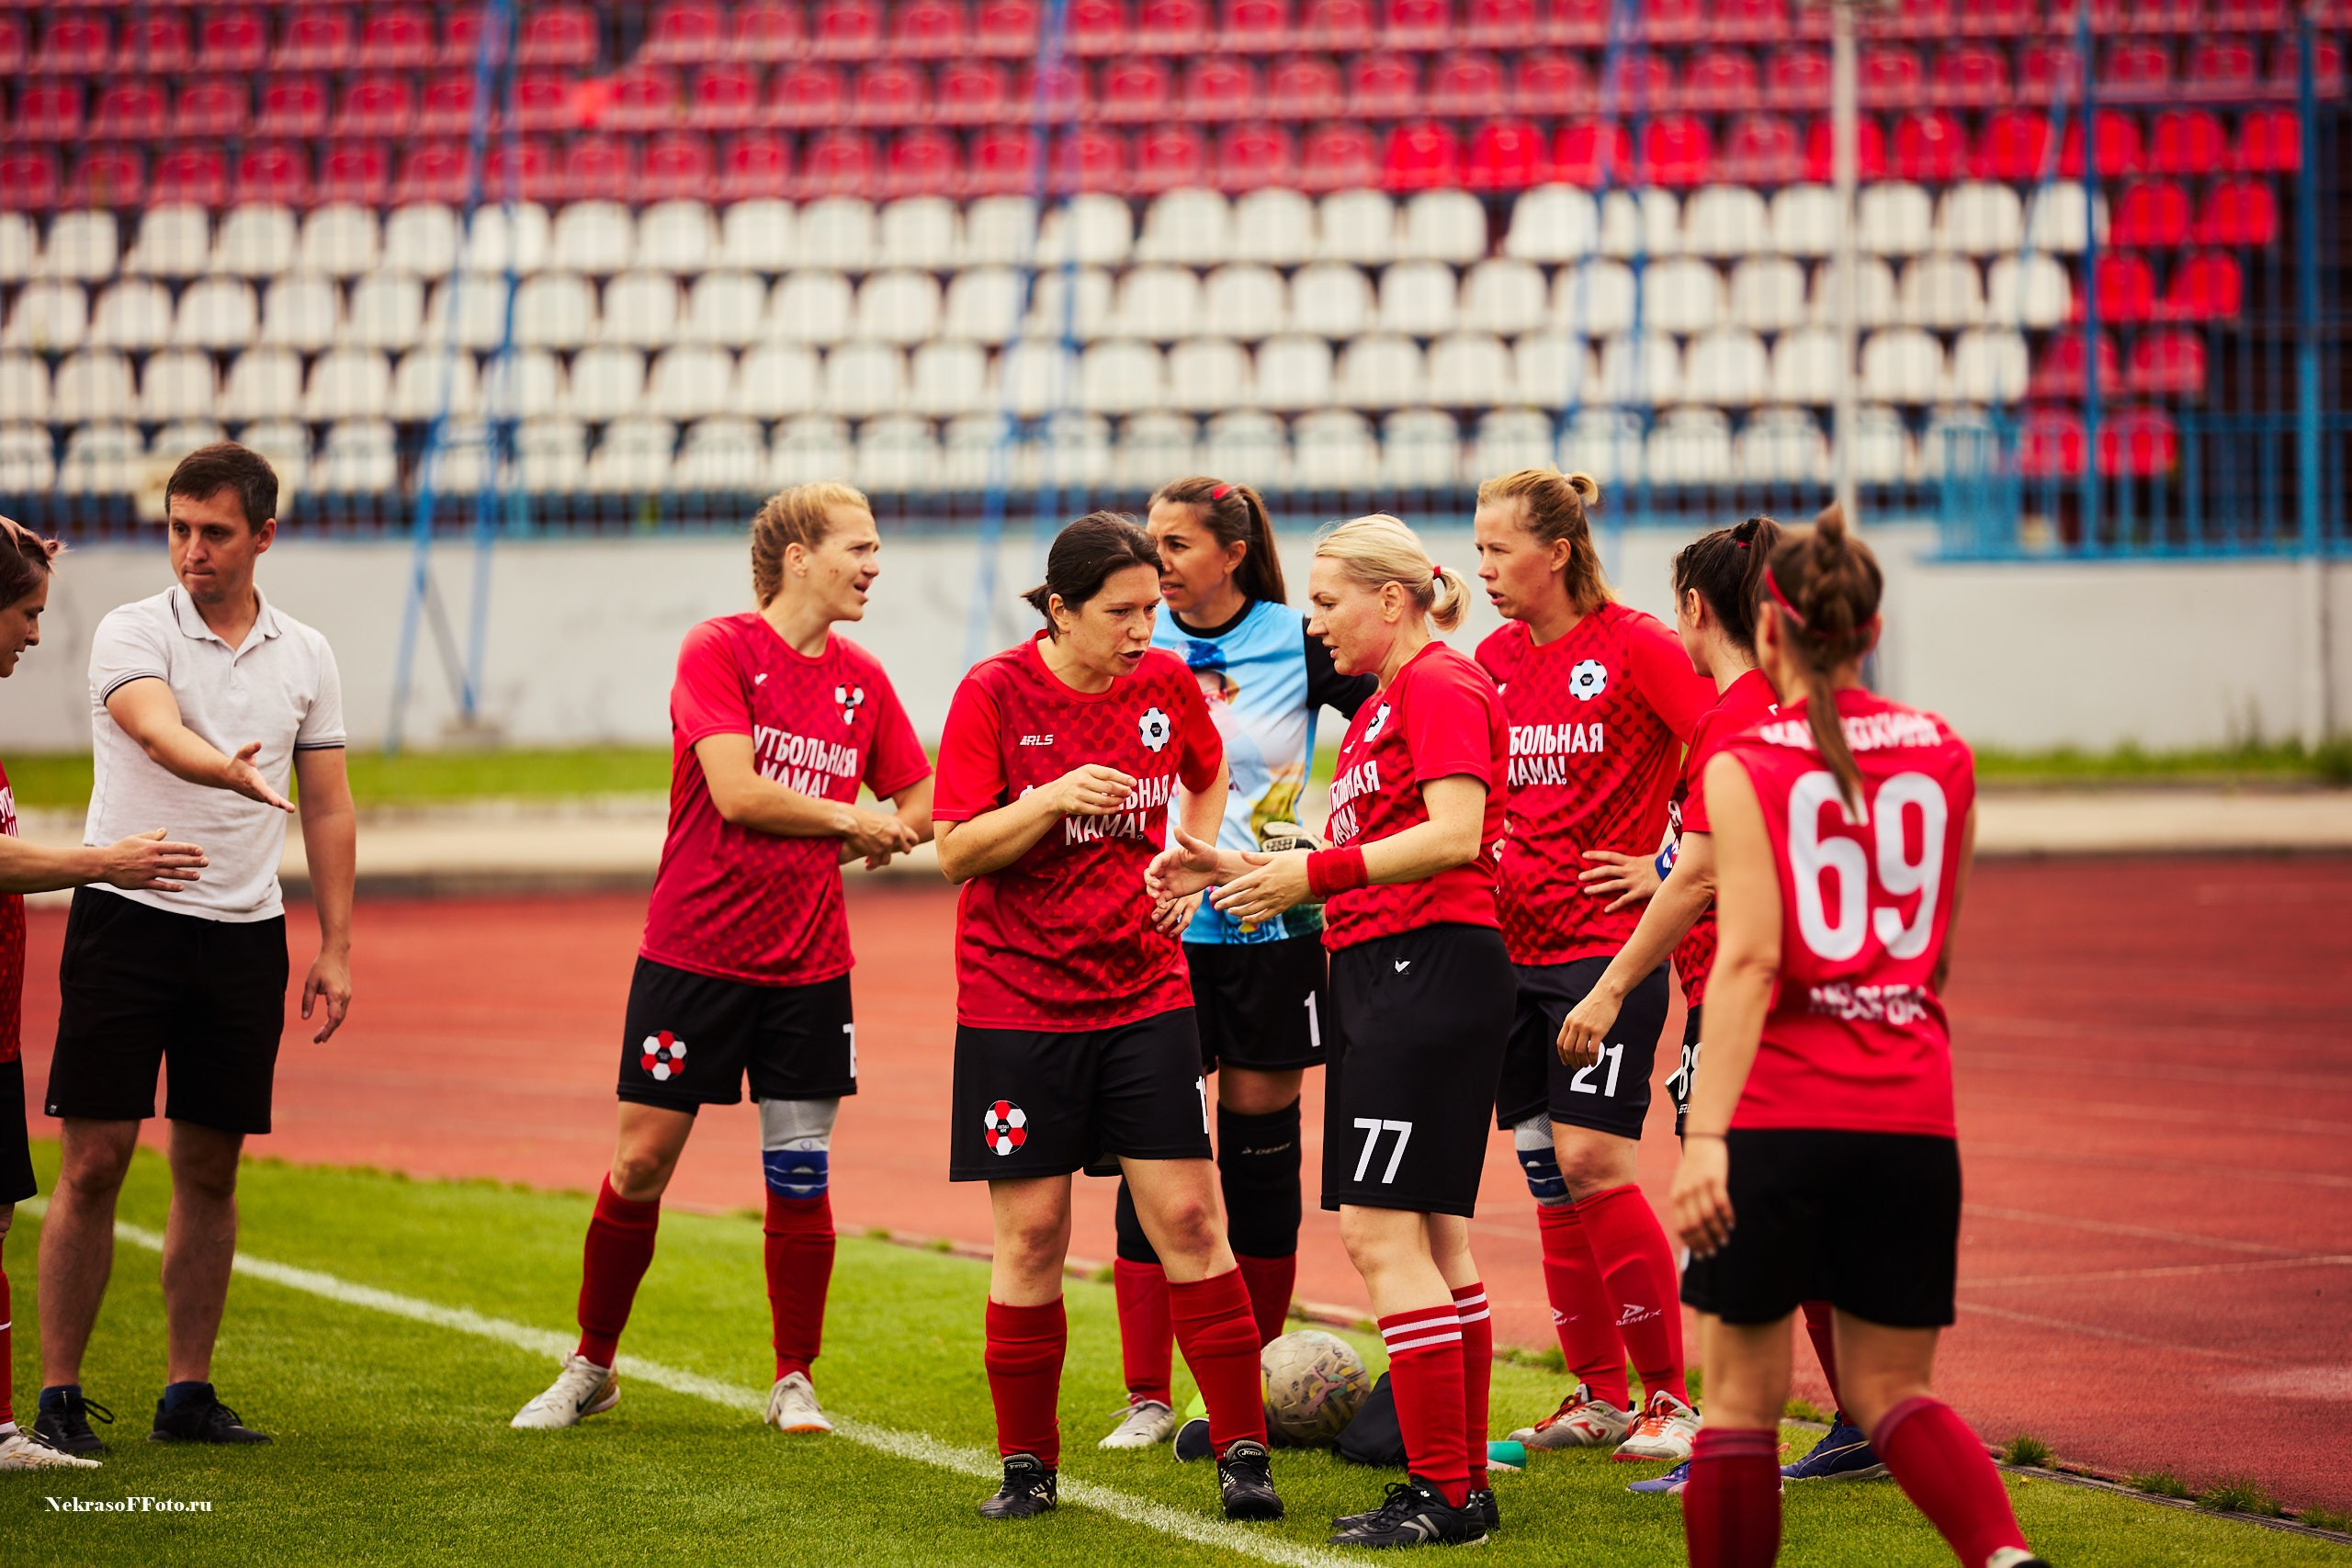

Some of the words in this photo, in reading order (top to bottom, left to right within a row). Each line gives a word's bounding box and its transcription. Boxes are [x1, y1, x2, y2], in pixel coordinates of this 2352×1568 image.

[753, 724, 858, 778] УТБОЛЬНАЯ
[1508, 723, 1603, 756] БОЛЬНАЯ
[1065, 810, 1147, 847] МАМА!
[1787, 770, 1948, 962] 69
[1304, 990, 1321, 1048] 1
[1569, 1039, 1624, 1098] 21
[1353, 1117, 1413, 1184] 77
